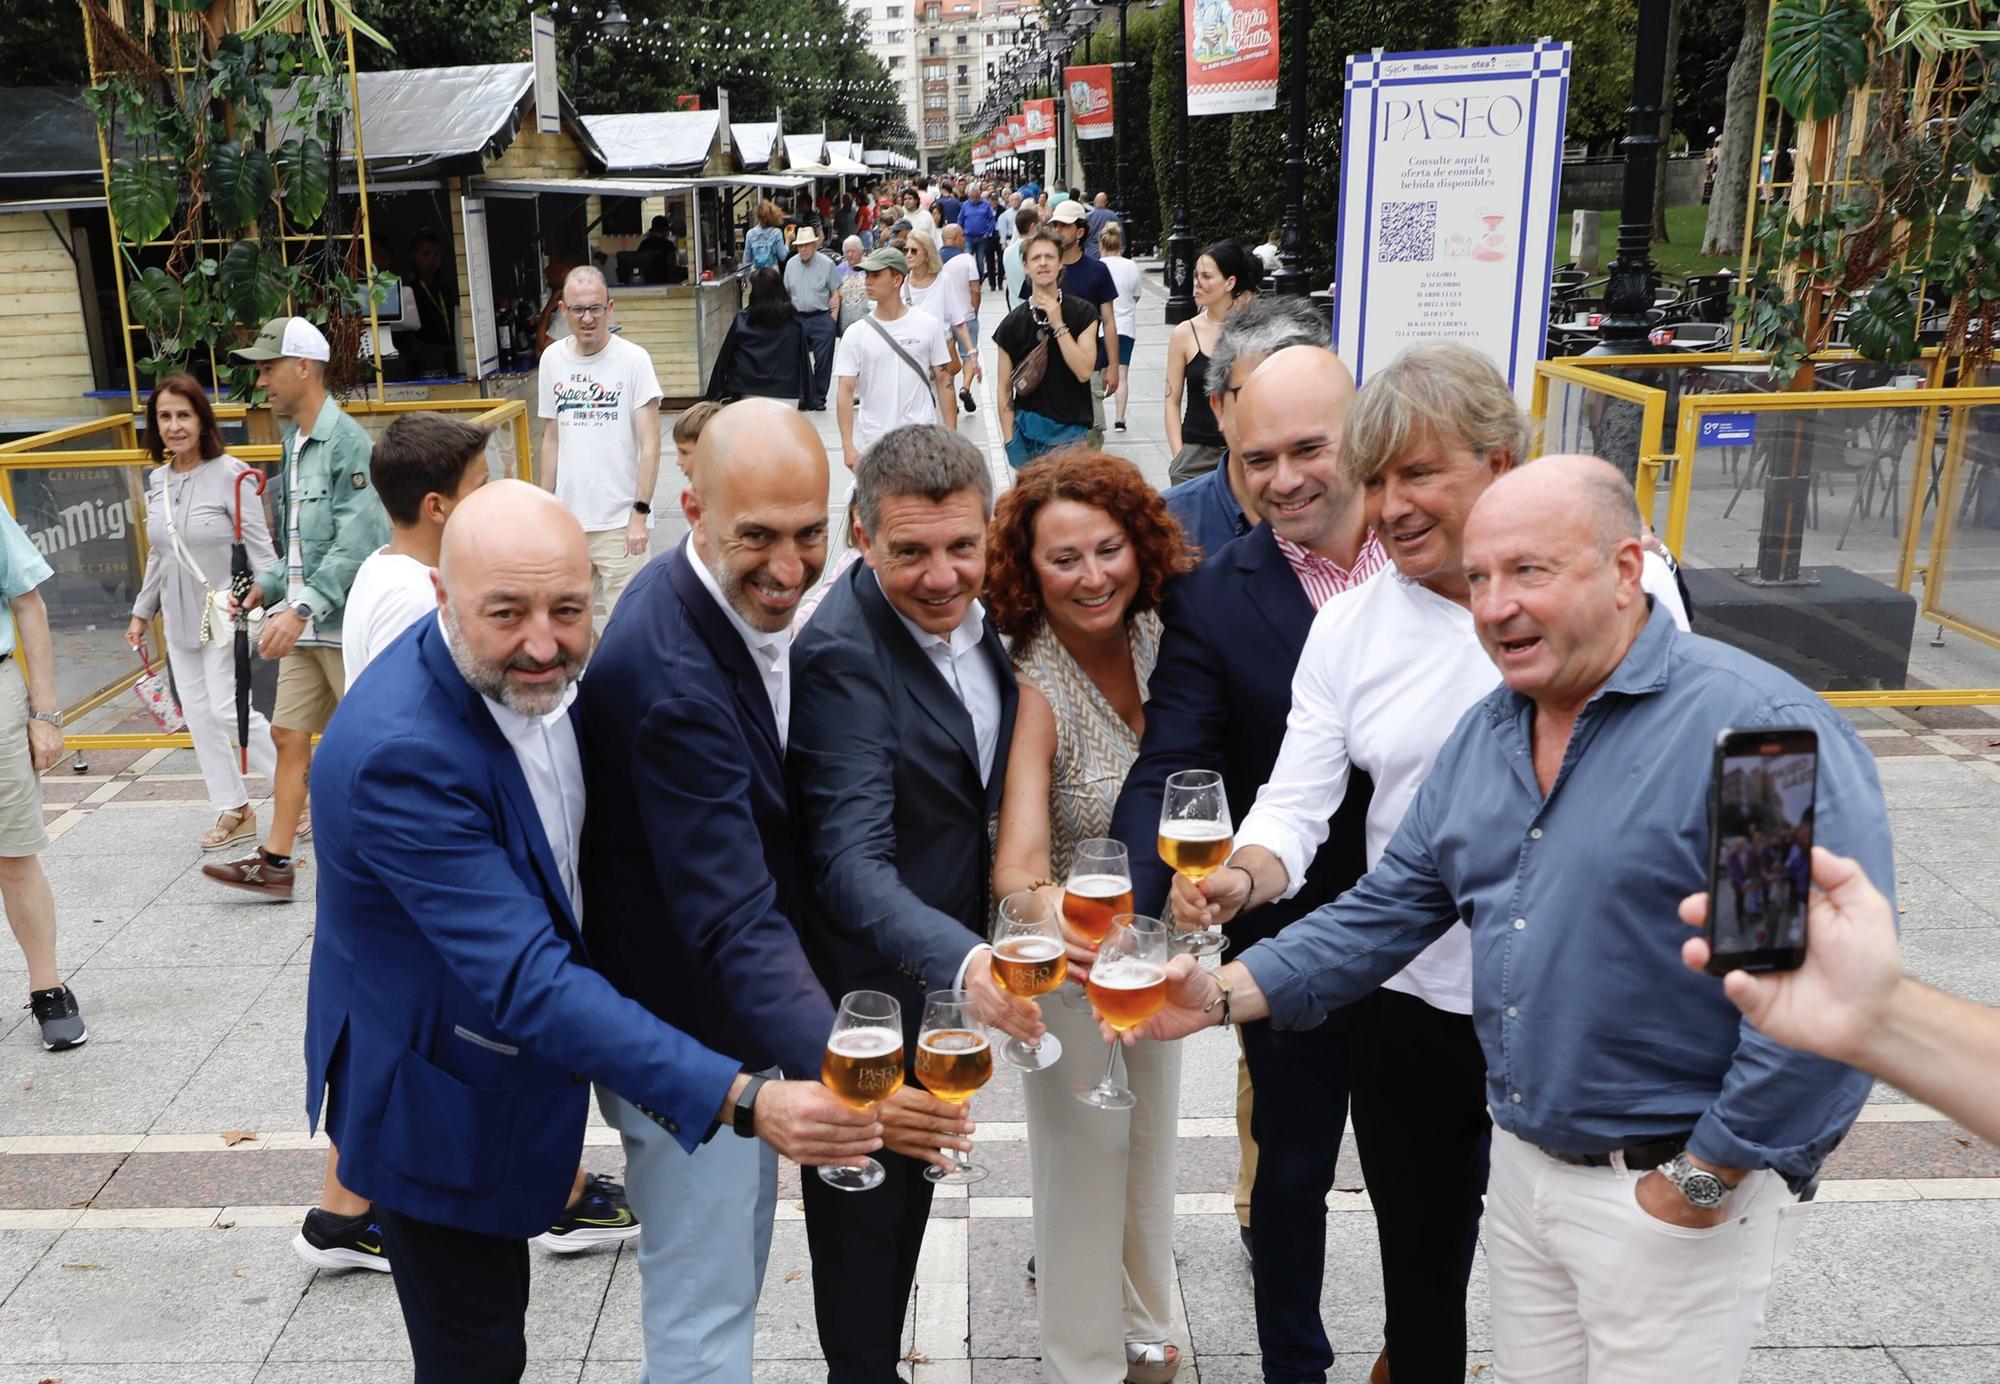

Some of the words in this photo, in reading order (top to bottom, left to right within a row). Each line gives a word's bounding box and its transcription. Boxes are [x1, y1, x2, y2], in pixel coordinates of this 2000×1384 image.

[1382, 95, 1523, 142] PASEO
[1408, 155, 1452, 167] Consulte
[1454, 154, 1478, 167] aquí
[1480, 154, 1490, 164] la
[1400, 168, 1431, 179] oferta
[1433, 168, 1446, 178] de
[1447, 165, 1485, 177] comida
[1487, 170, 1493, 179] y
[1400, 178, 1435, 190] bebida
[1437, 177, 1496, 190] disponibles
[570, 374, 593, 383] REAL
[48, 469, 109, 480] CERVEZAS
[859, 1065, 898, 1080] PASEO
